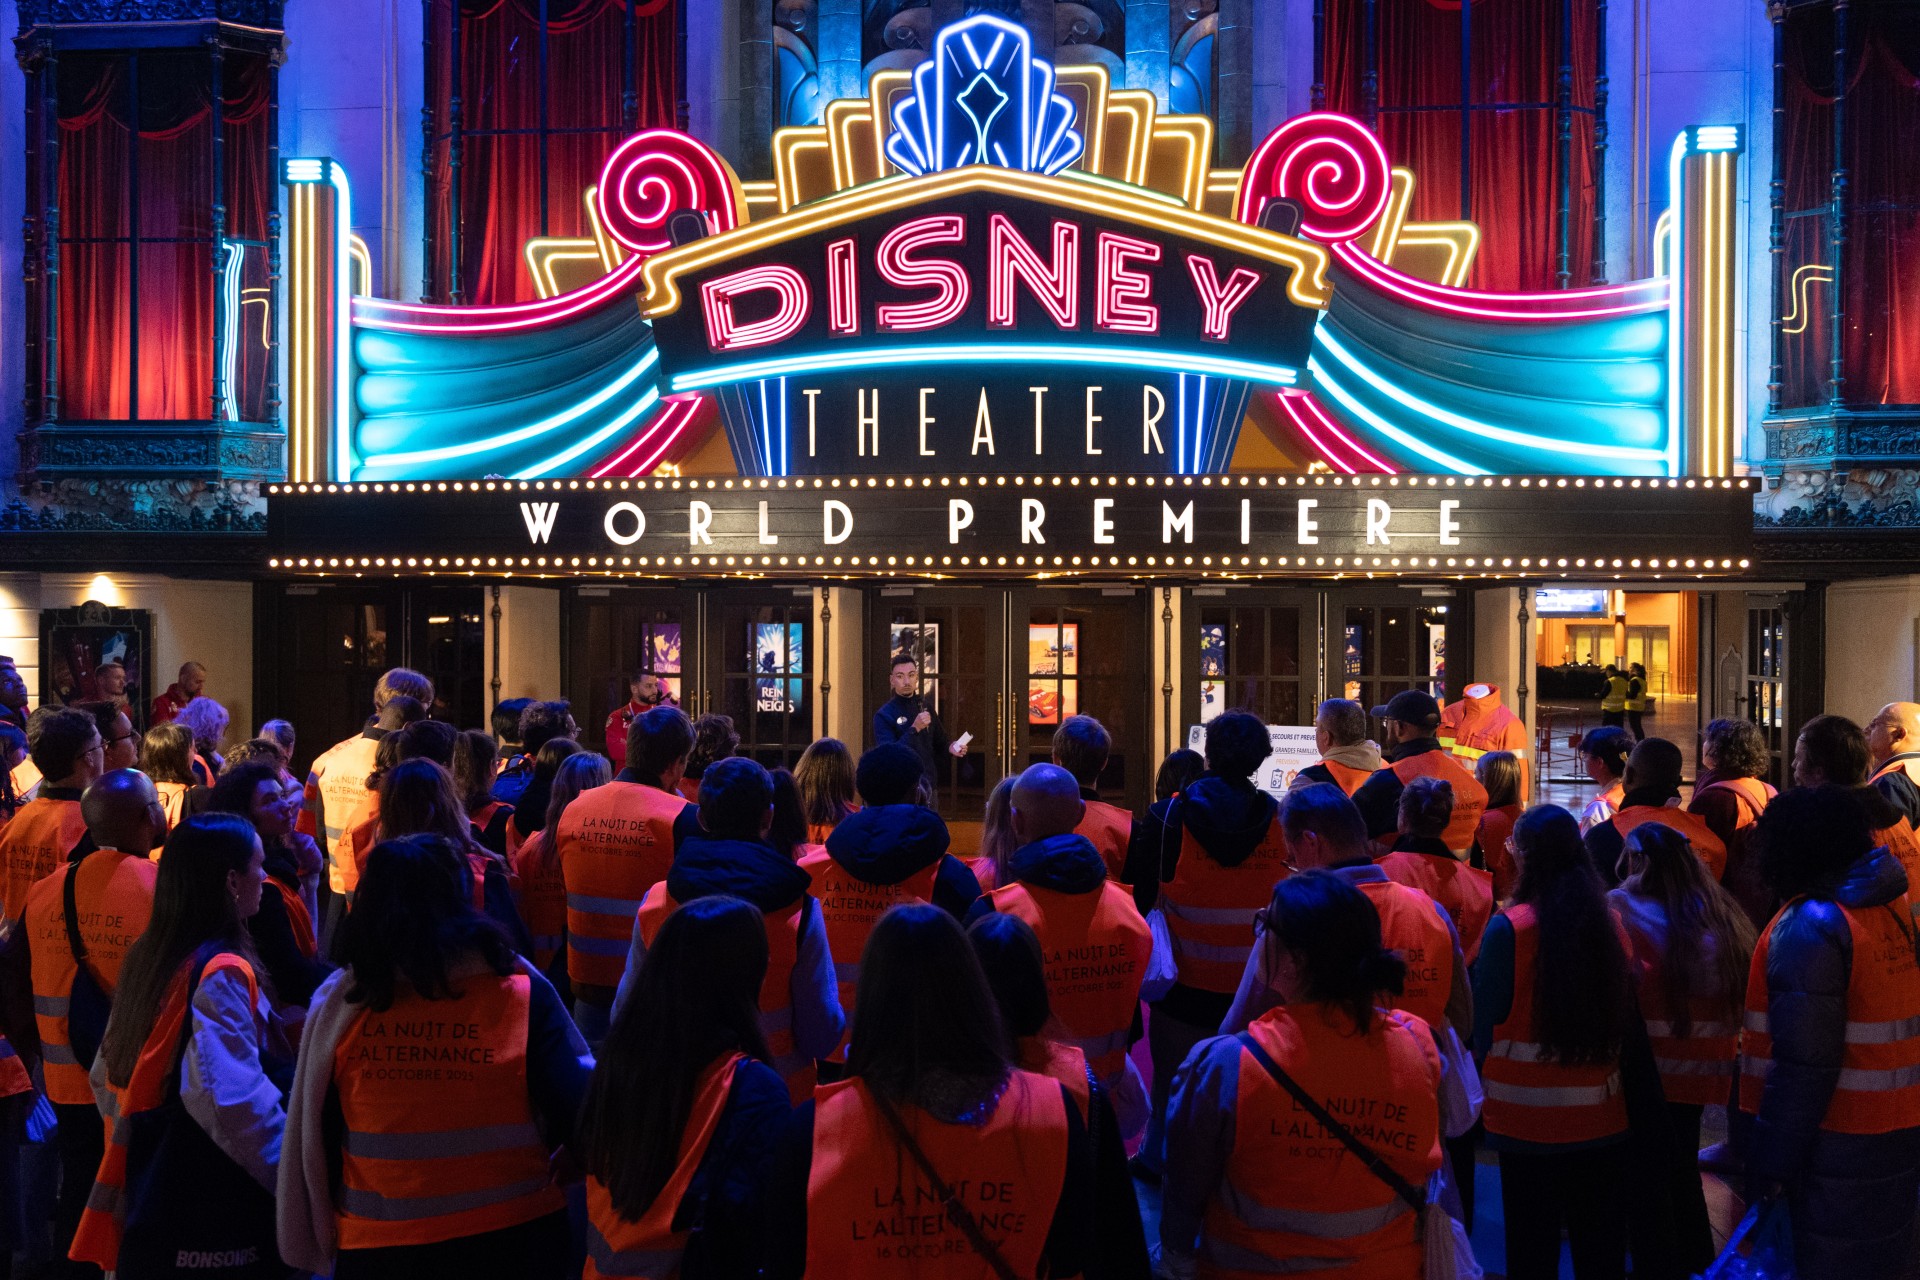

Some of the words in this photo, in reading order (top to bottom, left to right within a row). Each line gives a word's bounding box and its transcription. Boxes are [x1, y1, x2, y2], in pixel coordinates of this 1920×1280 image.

[701, 211, 1263, 351] DISNEY
[803, 384, 1166, 458] THEATER
[519, 500, 854, 546] WORLD
[948, 498, 1463, 546] PREMIERE
[762, 687, 785, 698] REIN
[757, 700, 795, 713] NEIGS
[583, 817, 596, 828] LA
[600, 818, 627, 831] NUIT
[630, 821, 646, 832] DE
[571, 831, 654, 847] L'ALTERNANCE
[40, 848, 52, 858] DE
[588, 846, 622, 857] OCTOBRE
[825, 881, 841, 892] LA
[885, 884, 902, 896] DE
[50, 911, 65, 922] LA
[78, 912, 102, 927] UIT
[105, 915, 124, 928] DE
[834, 914, 877, 923] OCTOBRE
[1044, 951, 1062, 964] LA
[1068, 946, 1104, 961] NUIT
[1109, 944, 1126, 957] DE
[1409, 949, 1425, 962] DE
[1045, 961, 1136, 981] ALTERNANCE
[1057, 983, 1104, 995] OCTOBRE
[362, 1021, 386, 1037] LA
[395, 1021, 445, 1040] NUIT
[452, 1023, 479, 1039] DE
[347, 1045, 495, 1064] ALTERNANCE
[361, 1069, 372, 1079] 16
[376, 1068, 441, 1080] OCTOBRE
[446, 1069, 474, 1081] 2025
[1326, 1097, 1378, 1119] NUIT
[1383, 1102, 1408, 1122] DE
[1288, 1146, 1301, 1157] 16
[874, 1185, 906, 1208] LA
[980, 1181, 1014, 1203] DE
[877, 1246, 892, 1258] 16
[897, 1240, 965, 1258] OCTORE
